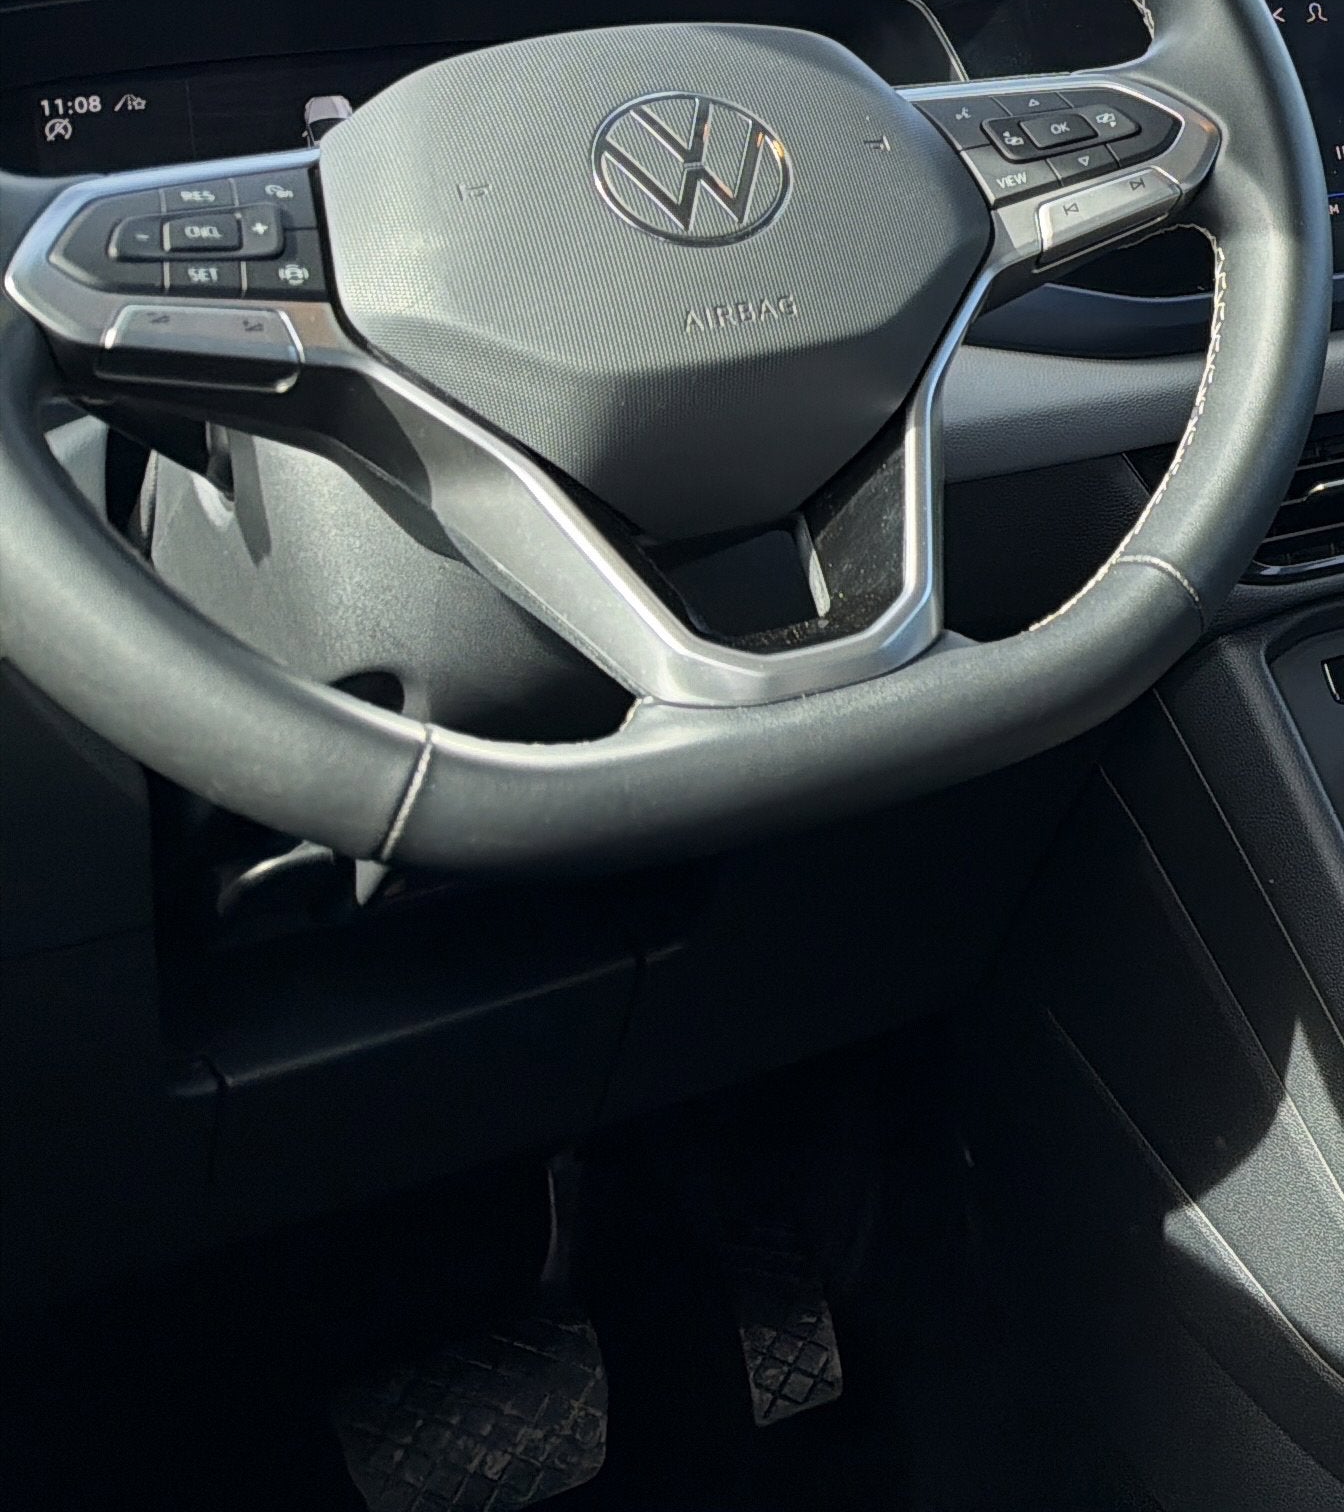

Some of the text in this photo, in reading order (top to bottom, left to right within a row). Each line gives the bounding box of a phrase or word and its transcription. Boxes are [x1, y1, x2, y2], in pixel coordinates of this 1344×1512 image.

[40, 95, 102, 117] 11:08
[1050, 121, 1071, 135] OK
[996, 171, 1028, 189] VIEW
[180, 190, 216, 202] RES
[187, 267, 219, 282] SET
[685, 294, 799, 334] AIRBAG
